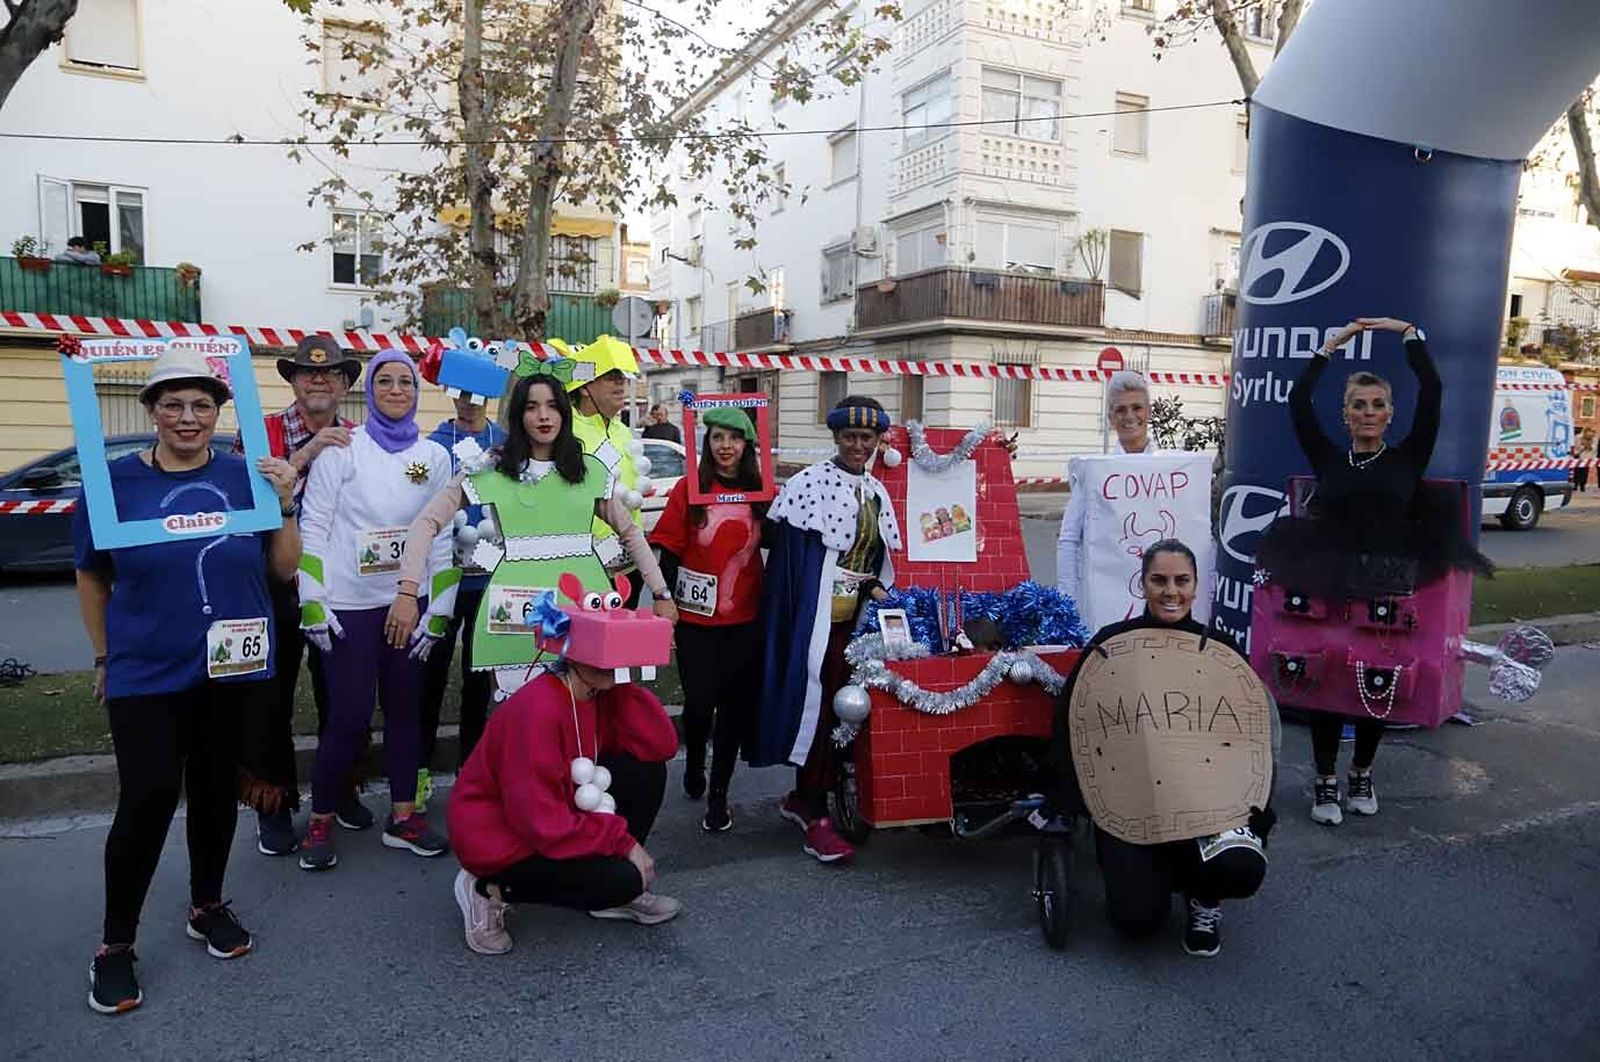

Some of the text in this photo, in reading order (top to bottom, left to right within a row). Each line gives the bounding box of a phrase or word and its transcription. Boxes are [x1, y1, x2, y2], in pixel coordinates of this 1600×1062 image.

[1103, 472, 1189, 499] COVAP
[167, 515, 224, 530] Claire
[691, 584, 708, 603] 64
[242, 635, 261, 658] 65
[1097, 691, 1242, 740] MARIA
